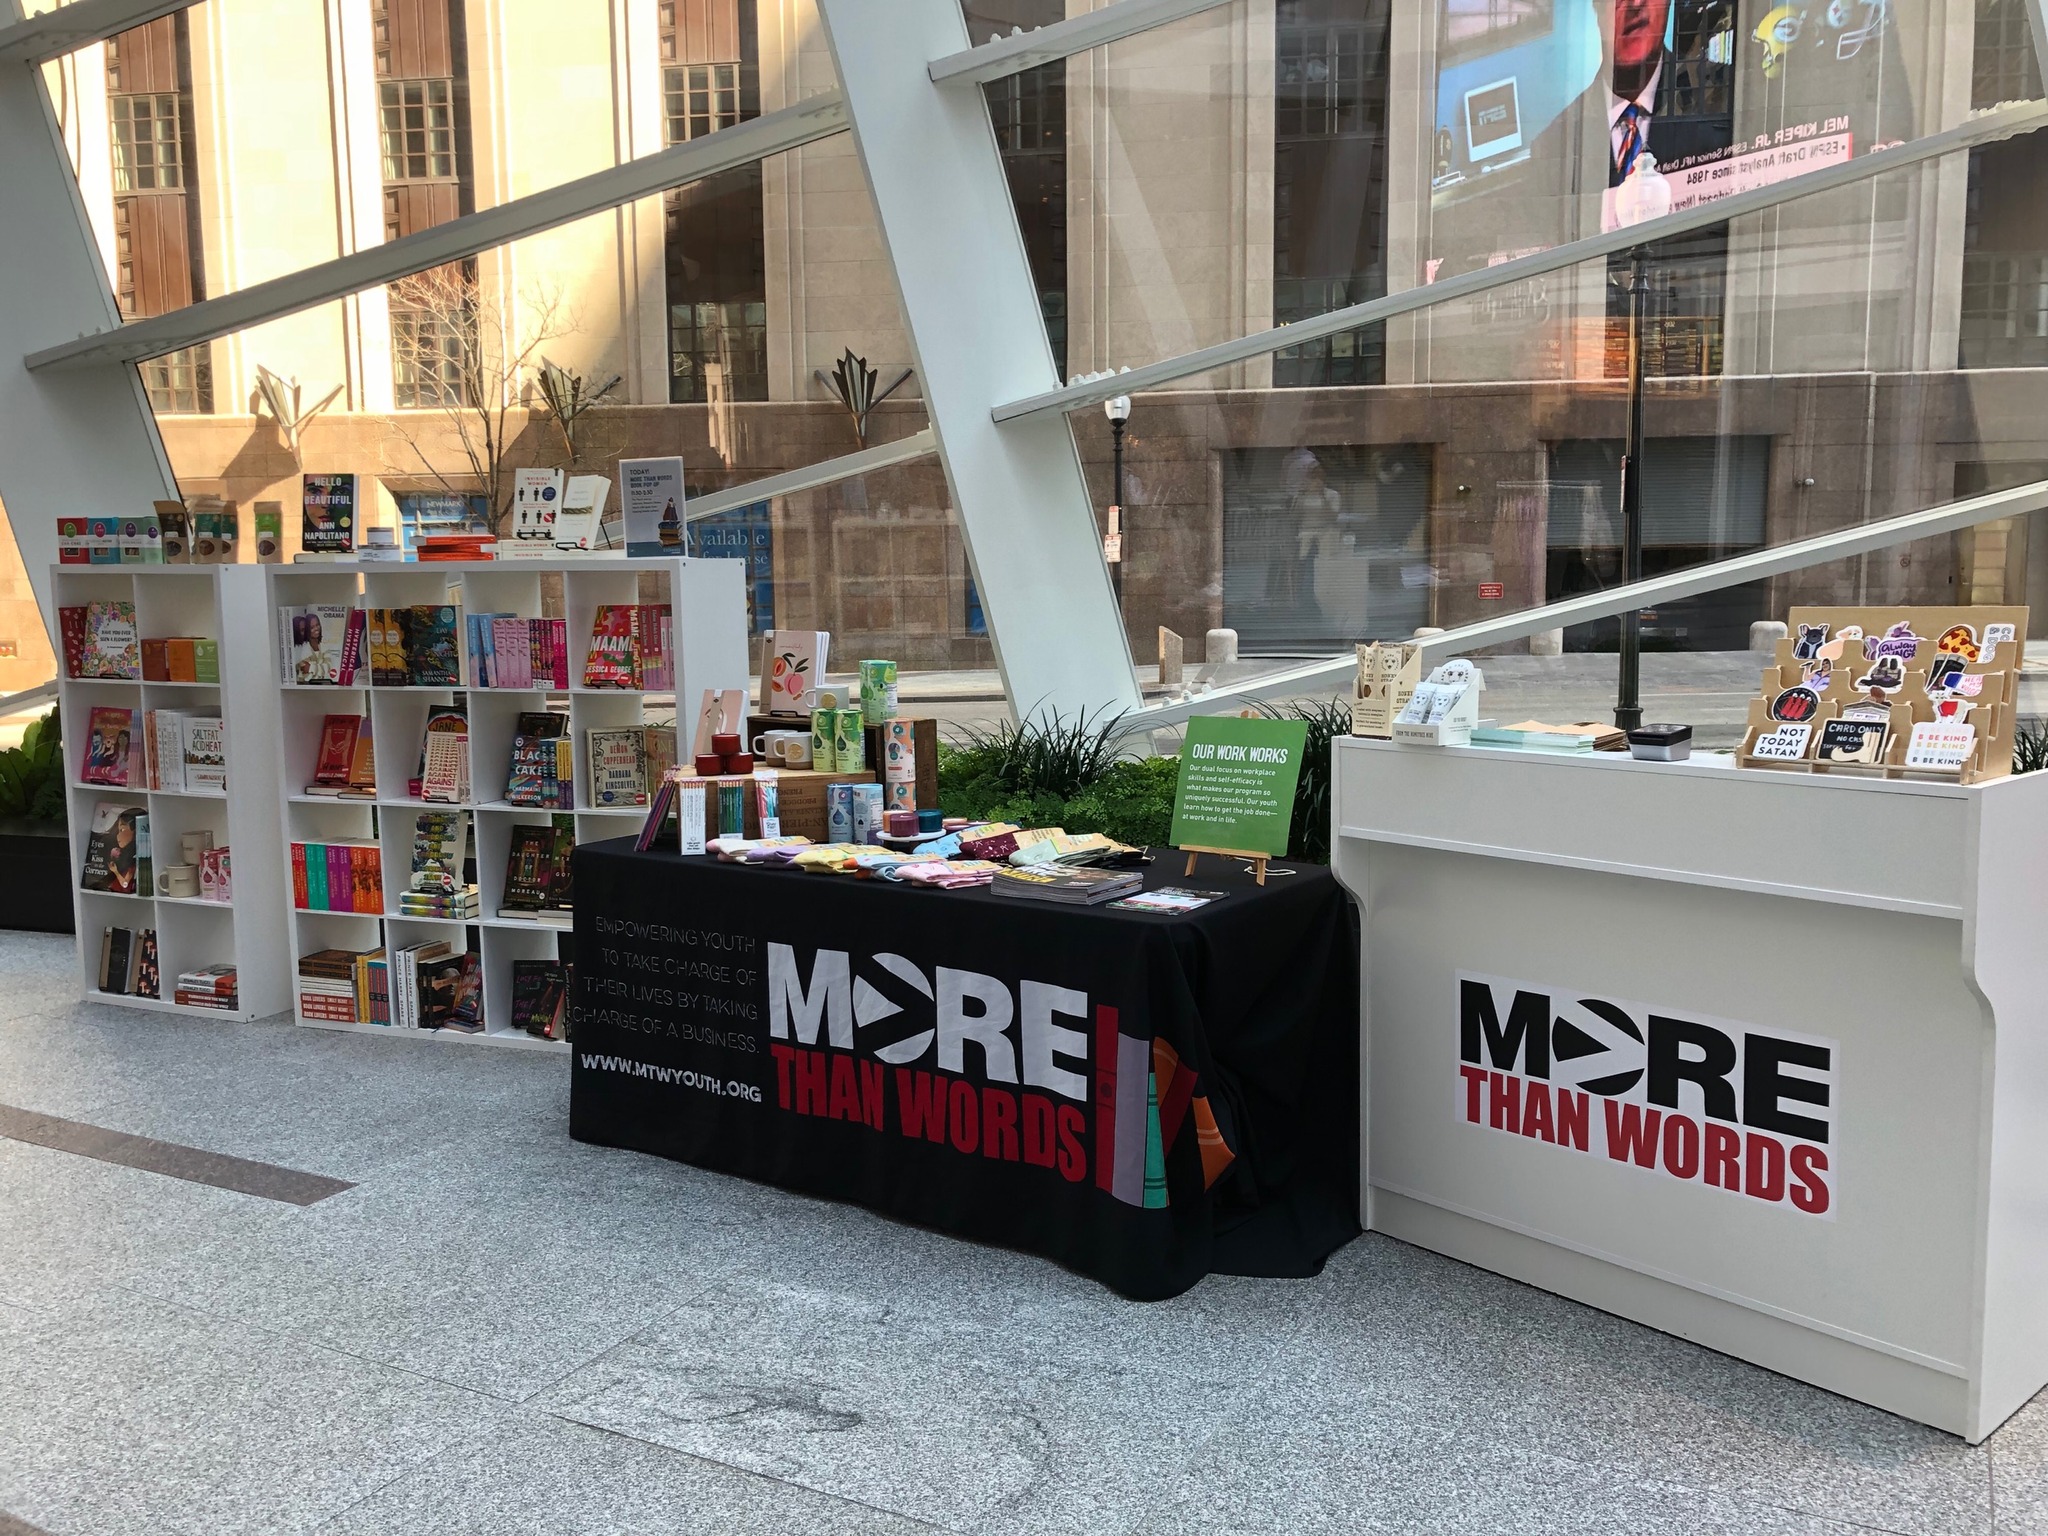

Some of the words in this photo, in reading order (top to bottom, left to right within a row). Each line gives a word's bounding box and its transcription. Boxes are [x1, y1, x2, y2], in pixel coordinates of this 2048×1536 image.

[315, 477, 342, 486] HELLO
[304, 496, 352, 504] BEAUTIFUL
[305, 532, 349, 540] NAPOLITANO
[341, 628, 351, 671] HYSTERICAL
[349, 629, 360, 671] HYSTERICAL
[585, 665, 608, 673] JESSICA
[433, 722, 456, 731] JANE
[1828, 723, 1856, 733] CARD
[1858, 725, 1883, 733] ONLY
[192, 729, 207, 740] SALT
[207, 730, 218, 740] FAT
[1780, 728, 1806, 737] NOT
[206, 741, 222, 752] HEAT
[1761, 736, 1802, 747] TODAY
[1192, 743, 1215, 759] OUR
[1217, 745, 1249, 762] WORK
[1250, 747, 1288, 764] WORKS
[1758, 746, 1798, 757] SATAN
[603, 756, 636, 765] COPPERHEAD
[515, 765, 542, 775] CAKE
[608, 770, 632, 779] BARBARA
[1216, 766, 1233, 774] focus
[1243, 768, 1276, 777] workplace
[427, 778, 457, 786] AGAINST
[605, 780, 636, 789] KINGSOLVER
[1218, 776, 1256, 786] self-efficacy
[1186, 784, 1201, 792] what
[1202, 784, 1222, 793] makes
[1235, 788, 1262, 796] program
[1185, 794, 1211, 803] uniquely
[1211, 795, 1245, 804] successful.
[1259, 799, 1277, 807] youth
[1183, 803, 1200, 811] learn
[1201, 804, 1213, 812] how
[1243, 807, 1254, 815] job
[1225, 816, 1237, 824] life.
[91, 840, 104, 848] Eyes
[91, 855, 104, 863] Kiss
[85, 866, 108, 876] Corners
[596, 916, 698, 945] EMPOWERING
[701, 931, 755, 953] YOUTH
[602, 948, 619, 966] TO
[624, 951, 660, 973] TAKE
[664, 958, 731, 983] CHARGE
[736, 969, 757, 986] OF
[583, 977, 627, 997] THEIR
[632, 985, 673, 1006] LIVES
[678, 992, 699, 1008] BY
[702, 995, 758, 1020] TAKING
[767, 942, 1088, 1102] MORE
[573, 1006, 637, 1031] CHARGE
[642, 1017, 662, 1034] OF
[666, 1022, 679, 1037] A
[683, 1023, 759, 1054] BUSINESS.
[1460, 979, 1831, 1145] MORE
[581, 1053, 761, 1102] WWW.MTWYOUTH.ORG
[770, 1043, 884, 1133] THAN
[895, 1068, 1087, 1182] WORDS
[1460, 1065, 1590, 1152] THAN
[1603, 1097, 1829, 1215] WORDS
